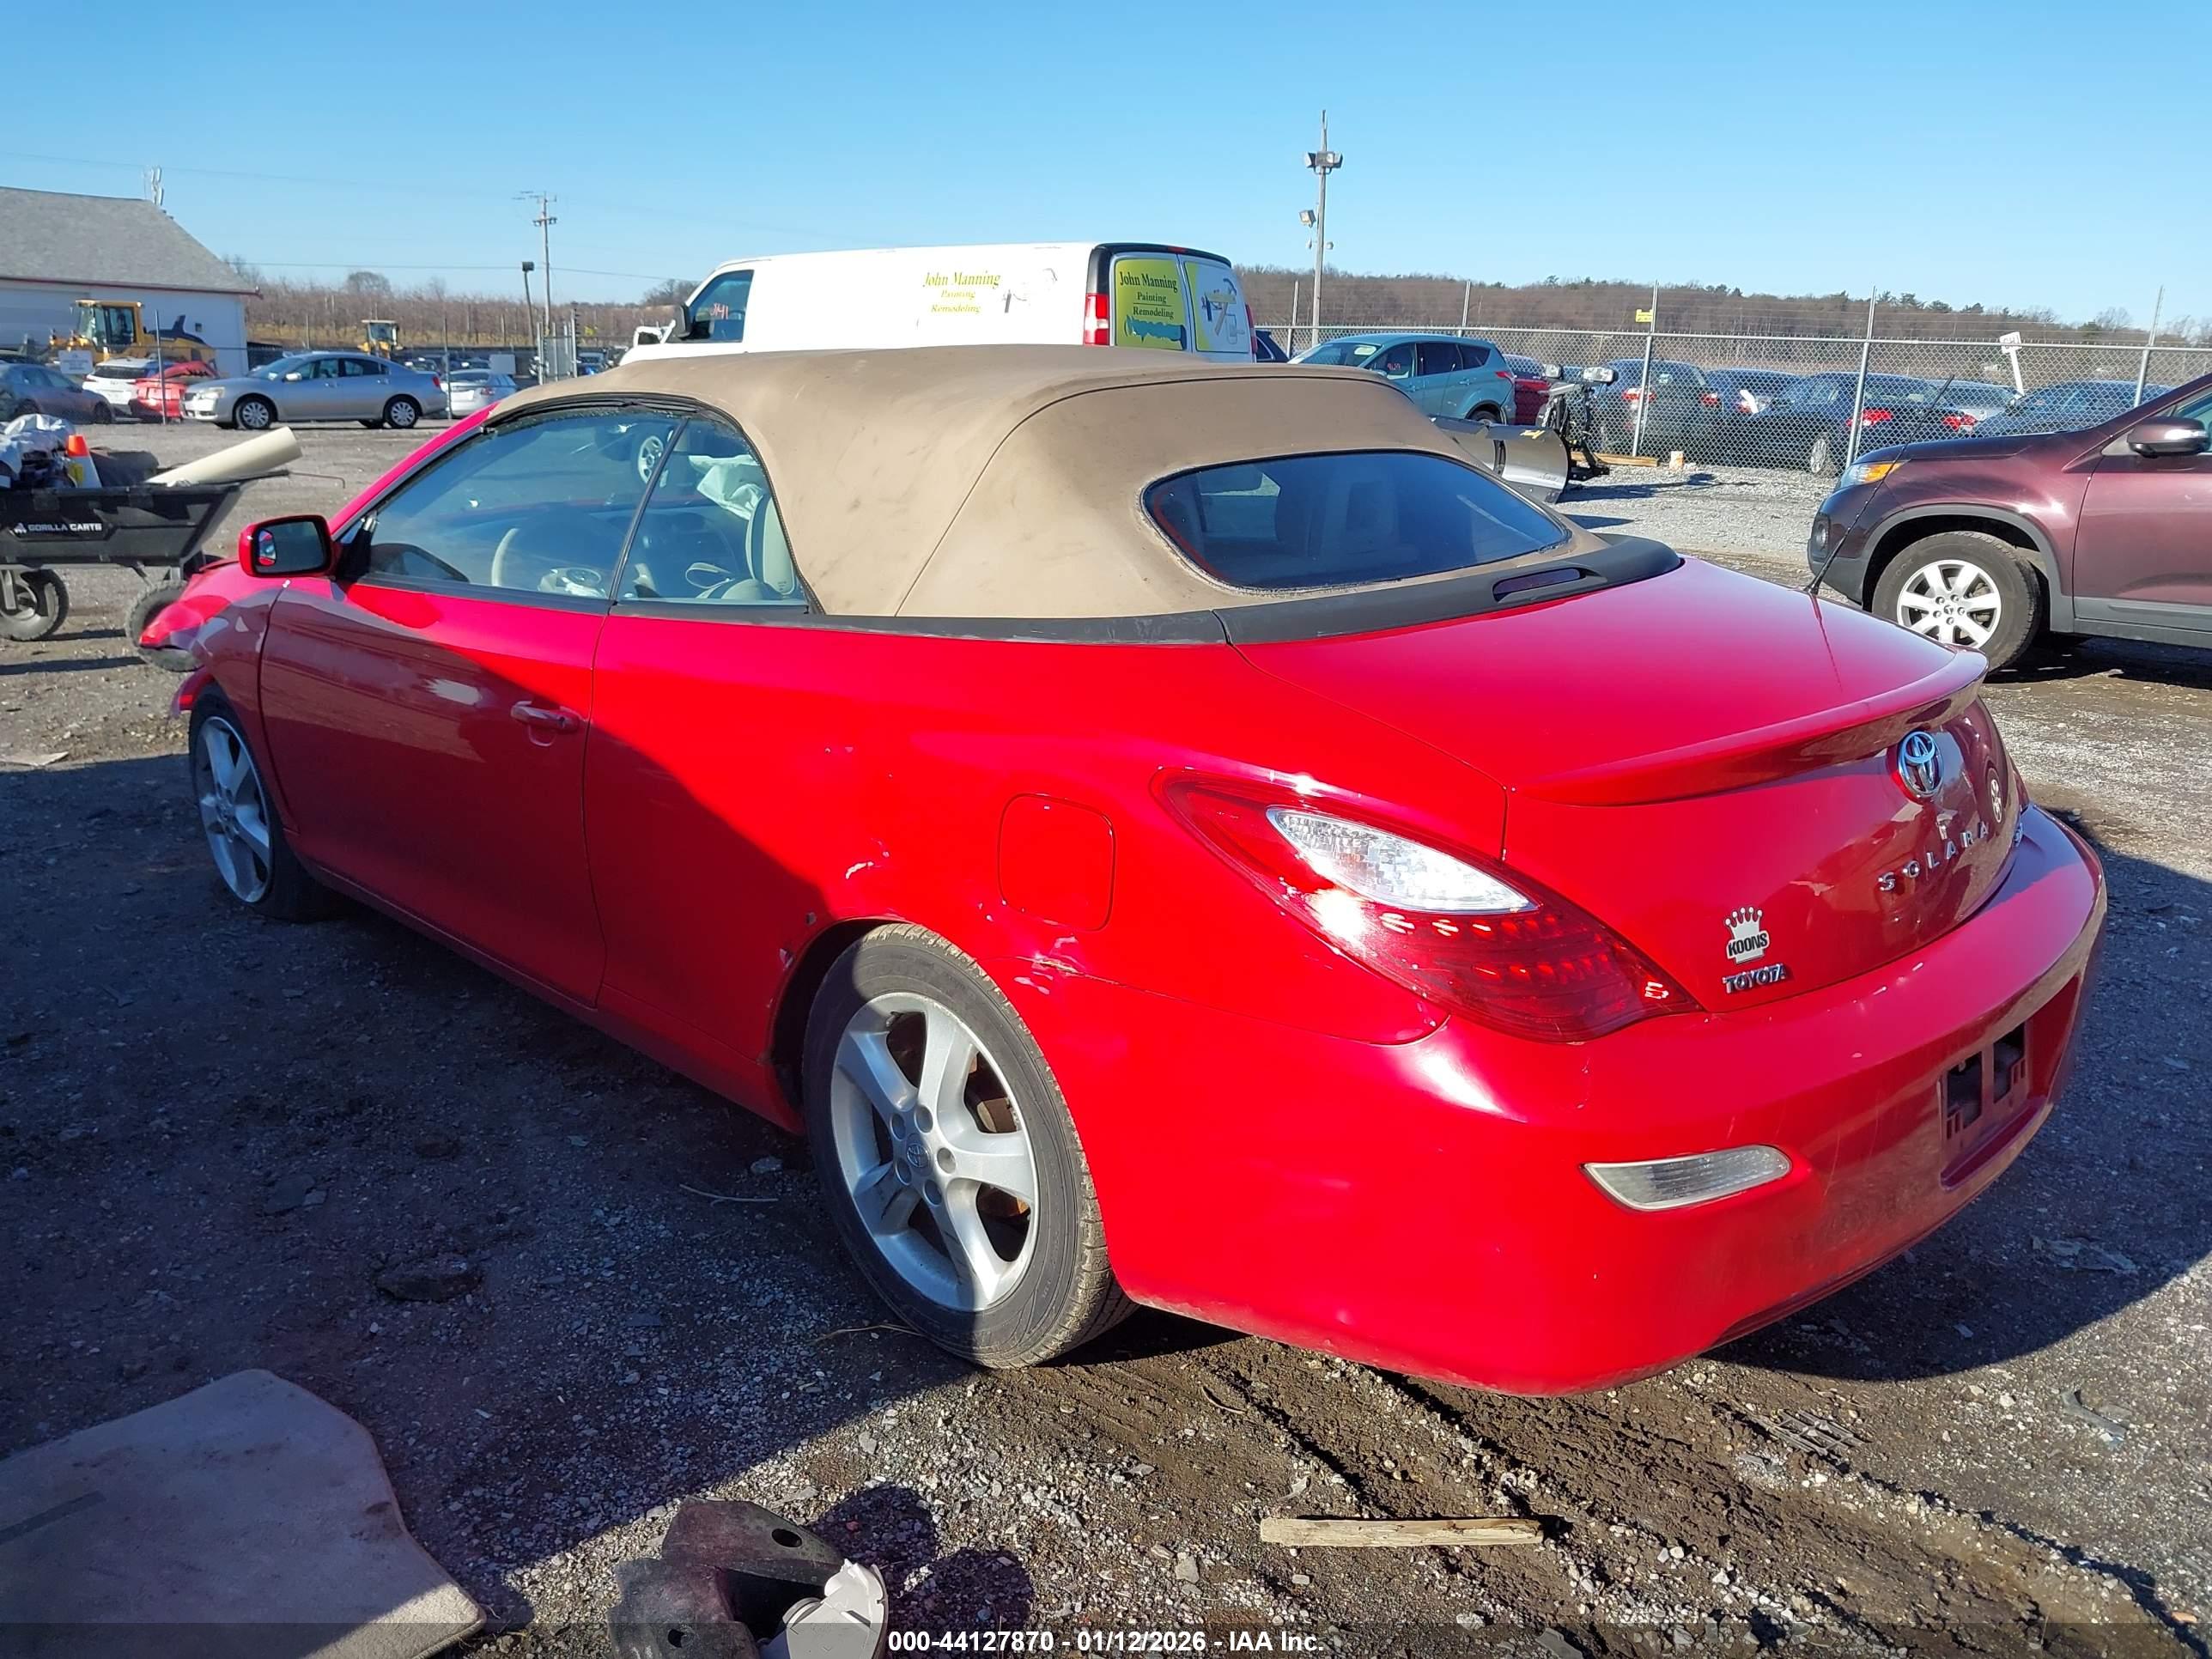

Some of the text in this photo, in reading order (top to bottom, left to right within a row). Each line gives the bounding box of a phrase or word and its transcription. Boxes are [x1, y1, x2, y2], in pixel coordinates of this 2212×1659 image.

[922, 270, 1001, 289] John Manning
[1119, 271, 1178, 294] John Manning
[1137, 291, 1167, 304] Painting
[1133, 306, 1174, 320] Remodeling
[27, 523, 103, 532] GORILLA CARTS
[1877, 820, 1990, 891] SOLARA
[1728, 932, 1769, 957] KOONS
[1722, 963, 1787, 994] TOYOTA
